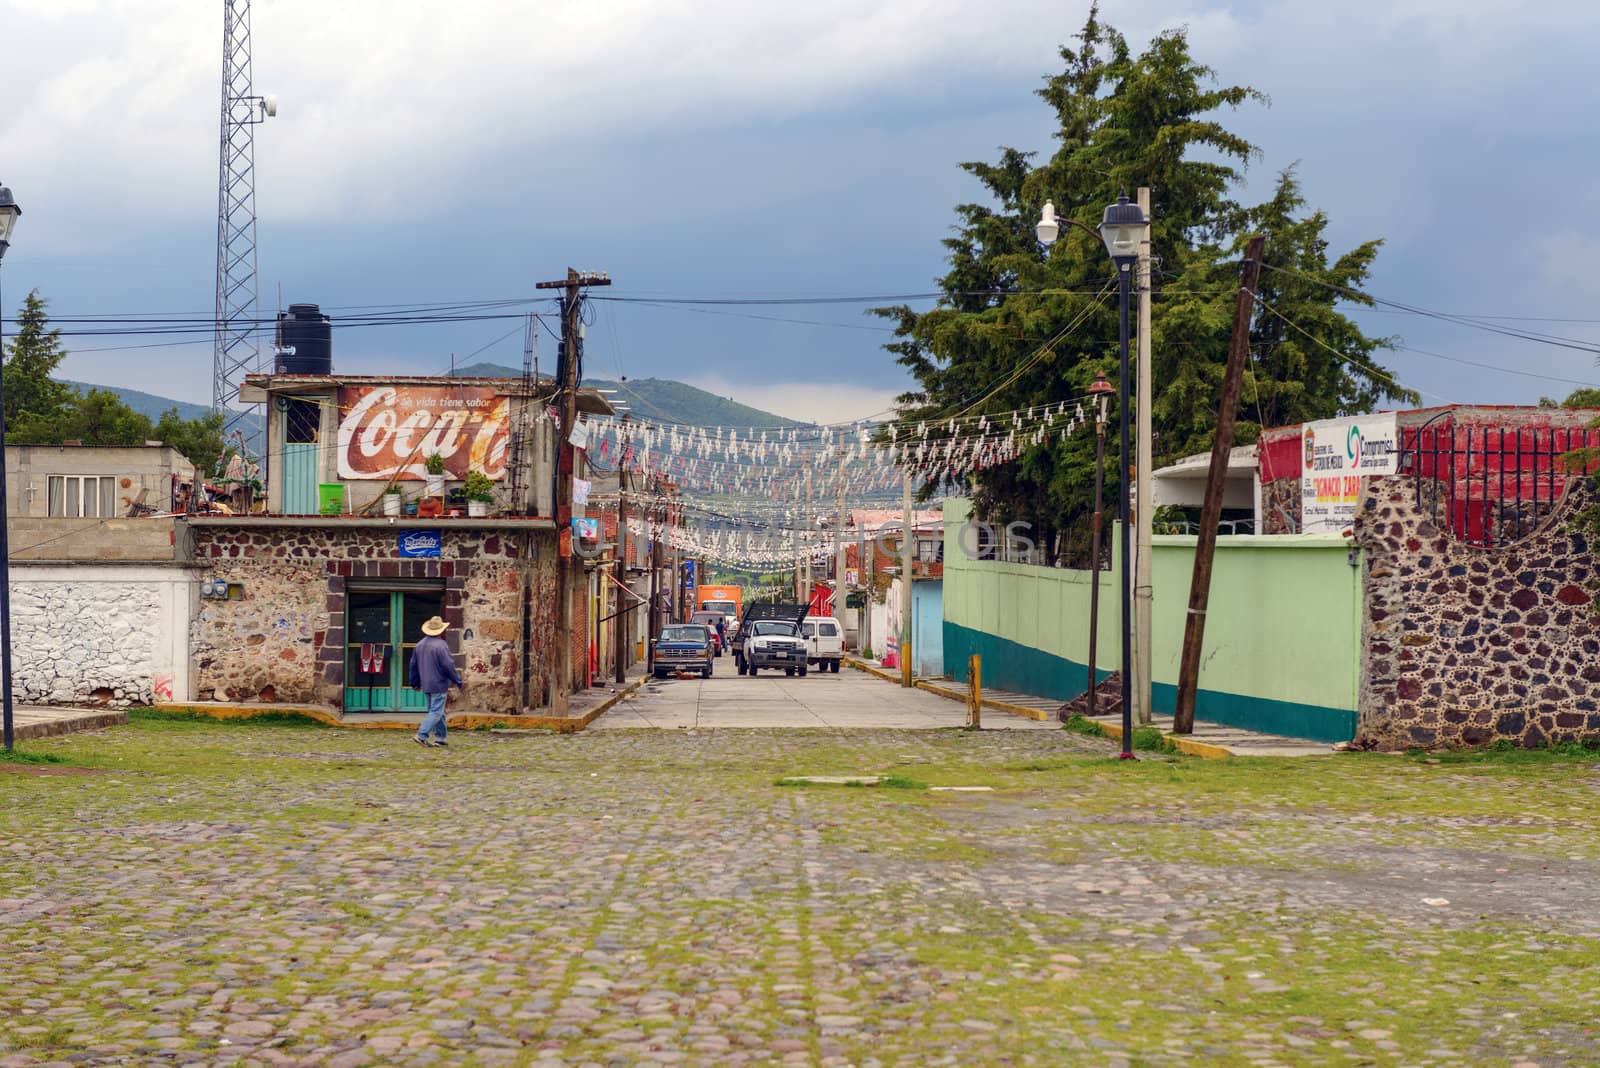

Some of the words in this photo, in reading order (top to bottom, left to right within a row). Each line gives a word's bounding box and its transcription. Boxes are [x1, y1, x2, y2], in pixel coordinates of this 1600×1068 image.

[416, 398, 436, 407] vida
[440, 397, 463, 407] tiene
[466, 397, 490, 407] sabor
[1360, 433, 1394, 458] Compromiso
